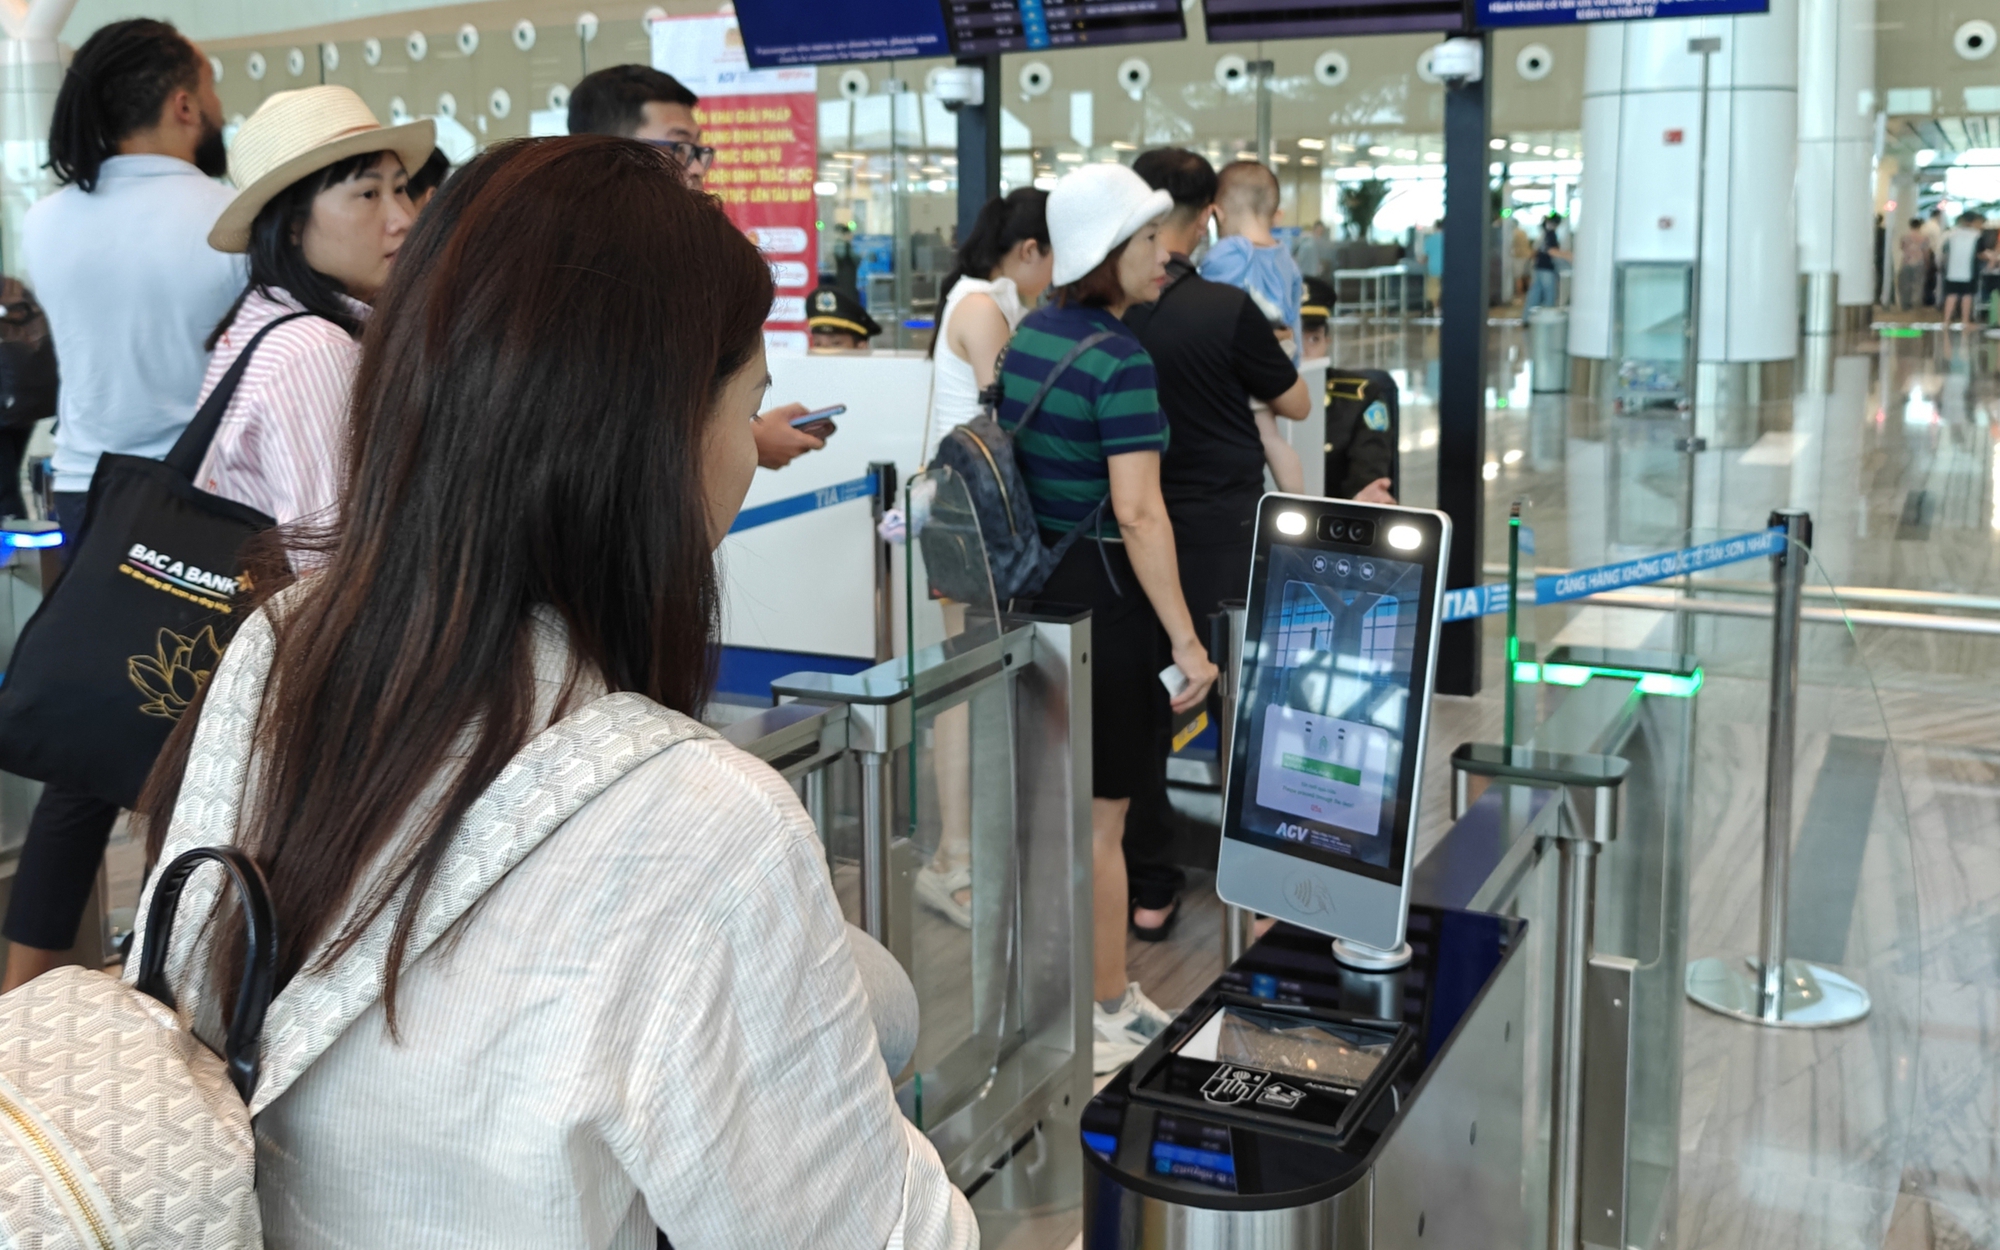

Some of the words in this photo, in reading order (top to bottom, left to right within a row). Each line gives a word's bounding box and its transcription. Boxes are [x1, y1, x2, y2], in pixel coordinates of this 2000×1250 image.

[129, 544, 170, 569] BAC
[167, 561, 184, 577] A
[184, 566, 239, 595] BANK
[1276, 822, 1308, 841] ACV
